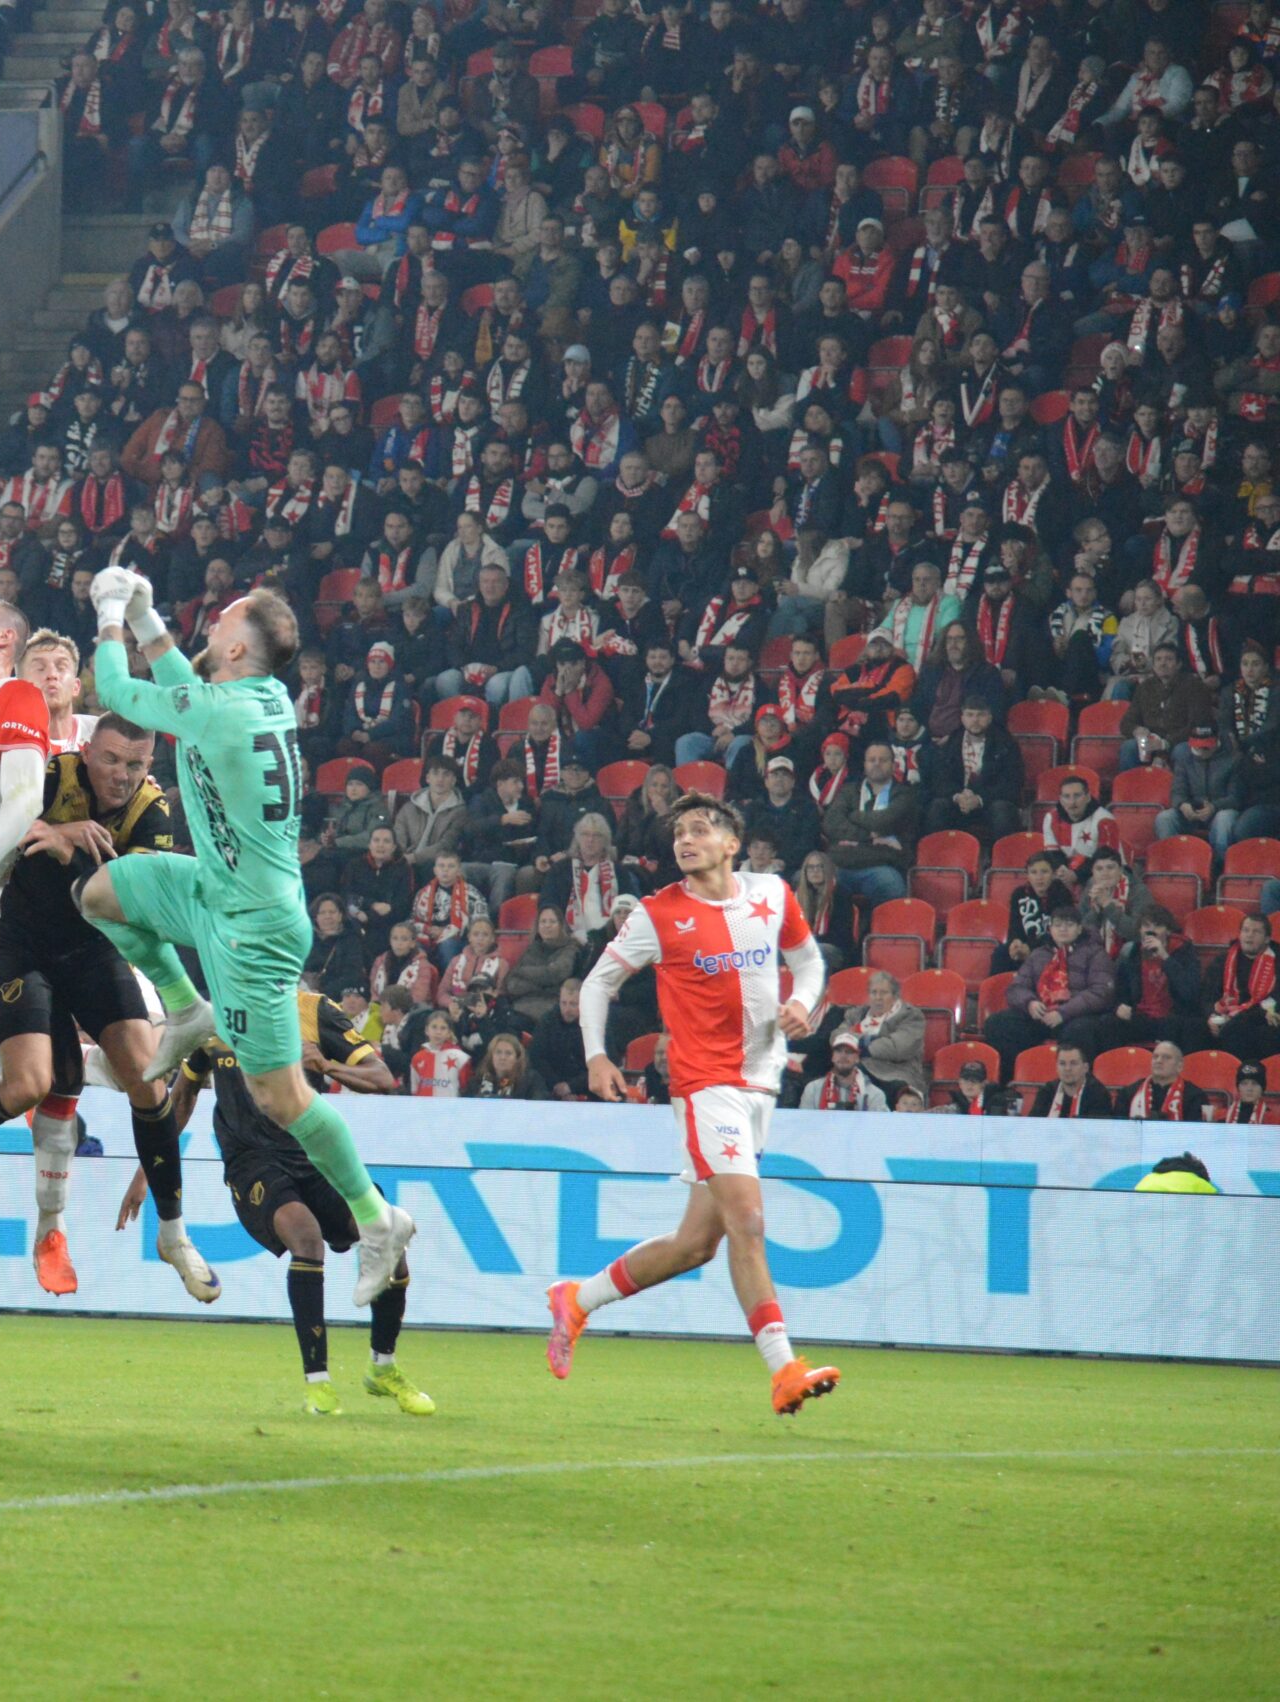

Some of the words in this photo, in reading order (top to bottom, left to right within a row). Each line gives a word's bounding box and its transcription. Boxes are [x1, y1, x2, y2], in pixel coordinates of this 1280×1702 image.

[223, 1006, 248, 1034] 30
[218, 1056, 240, 1069] FO
[715, 1125, 741, 1135] VISA
